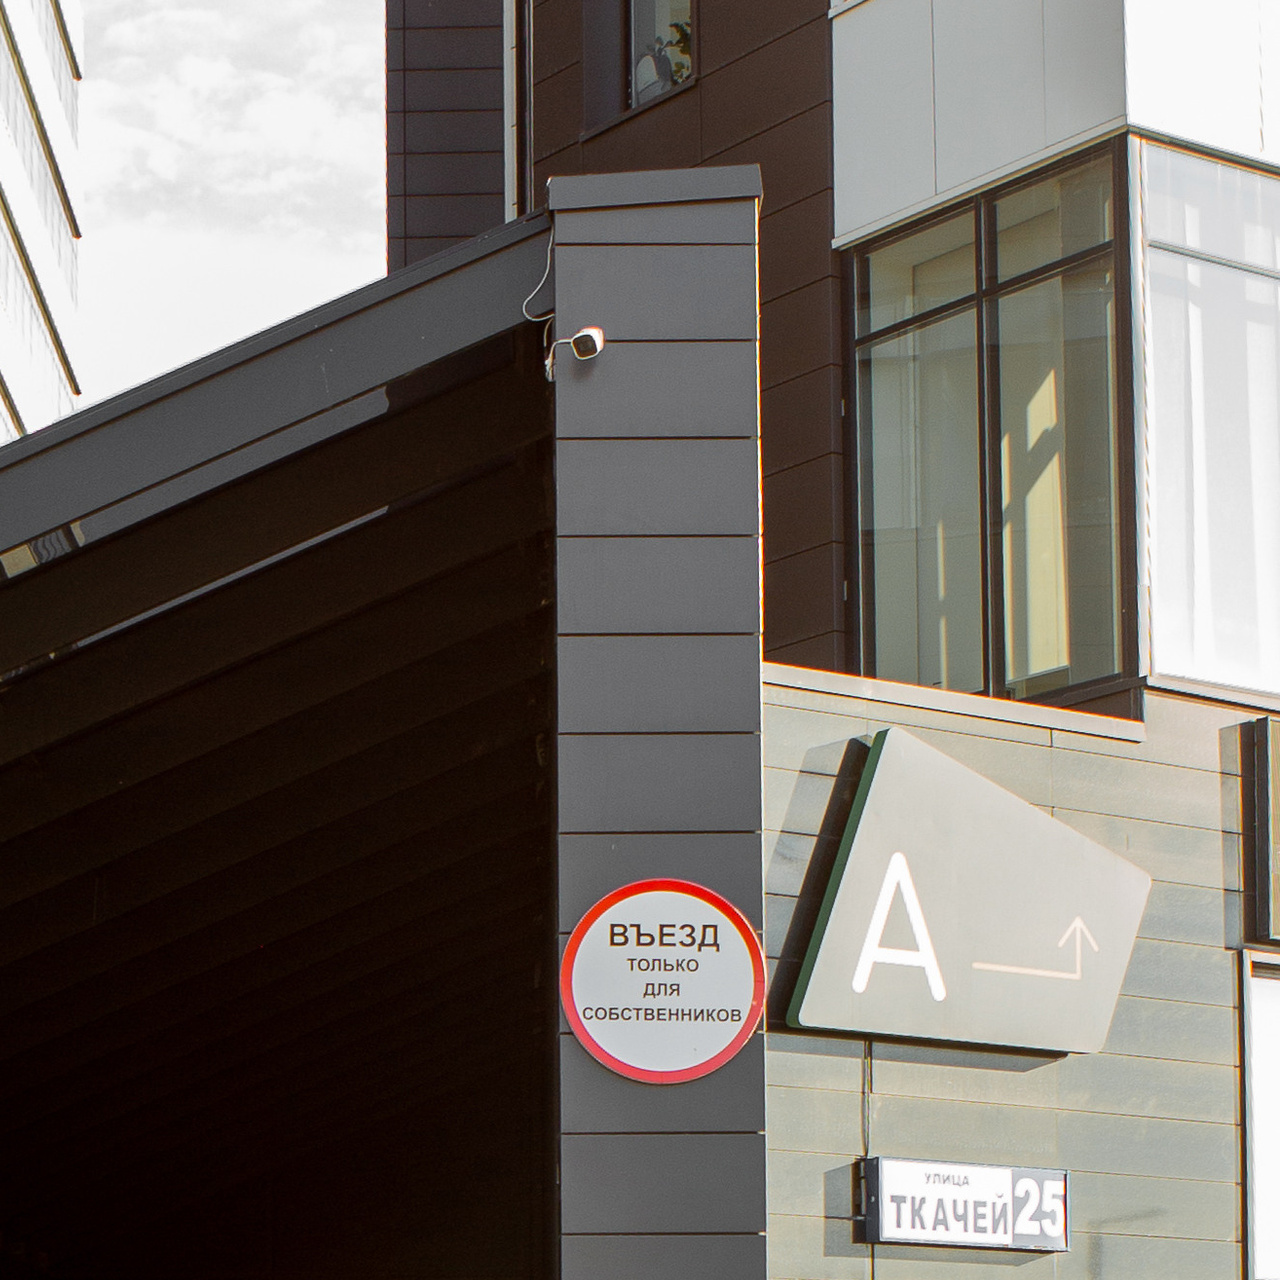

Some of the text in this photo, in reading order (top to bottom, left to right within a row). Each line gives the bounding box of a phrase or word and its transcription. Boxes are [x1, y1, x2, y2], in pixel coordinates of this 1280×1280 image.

[609, 923, 720, 952] ВЪЕЗД
[627, 958, 700, 972] ТОЛЬКО
[643, 983, 681, 998] ДЛЯ
[582, 1007, 742, 1022] СОБСТВЕННИКОВ
[924, 1172, 970, 1186] УЛИЦА
[890, 1177, 1065, 1238] ТКАЧЕЙ 25
